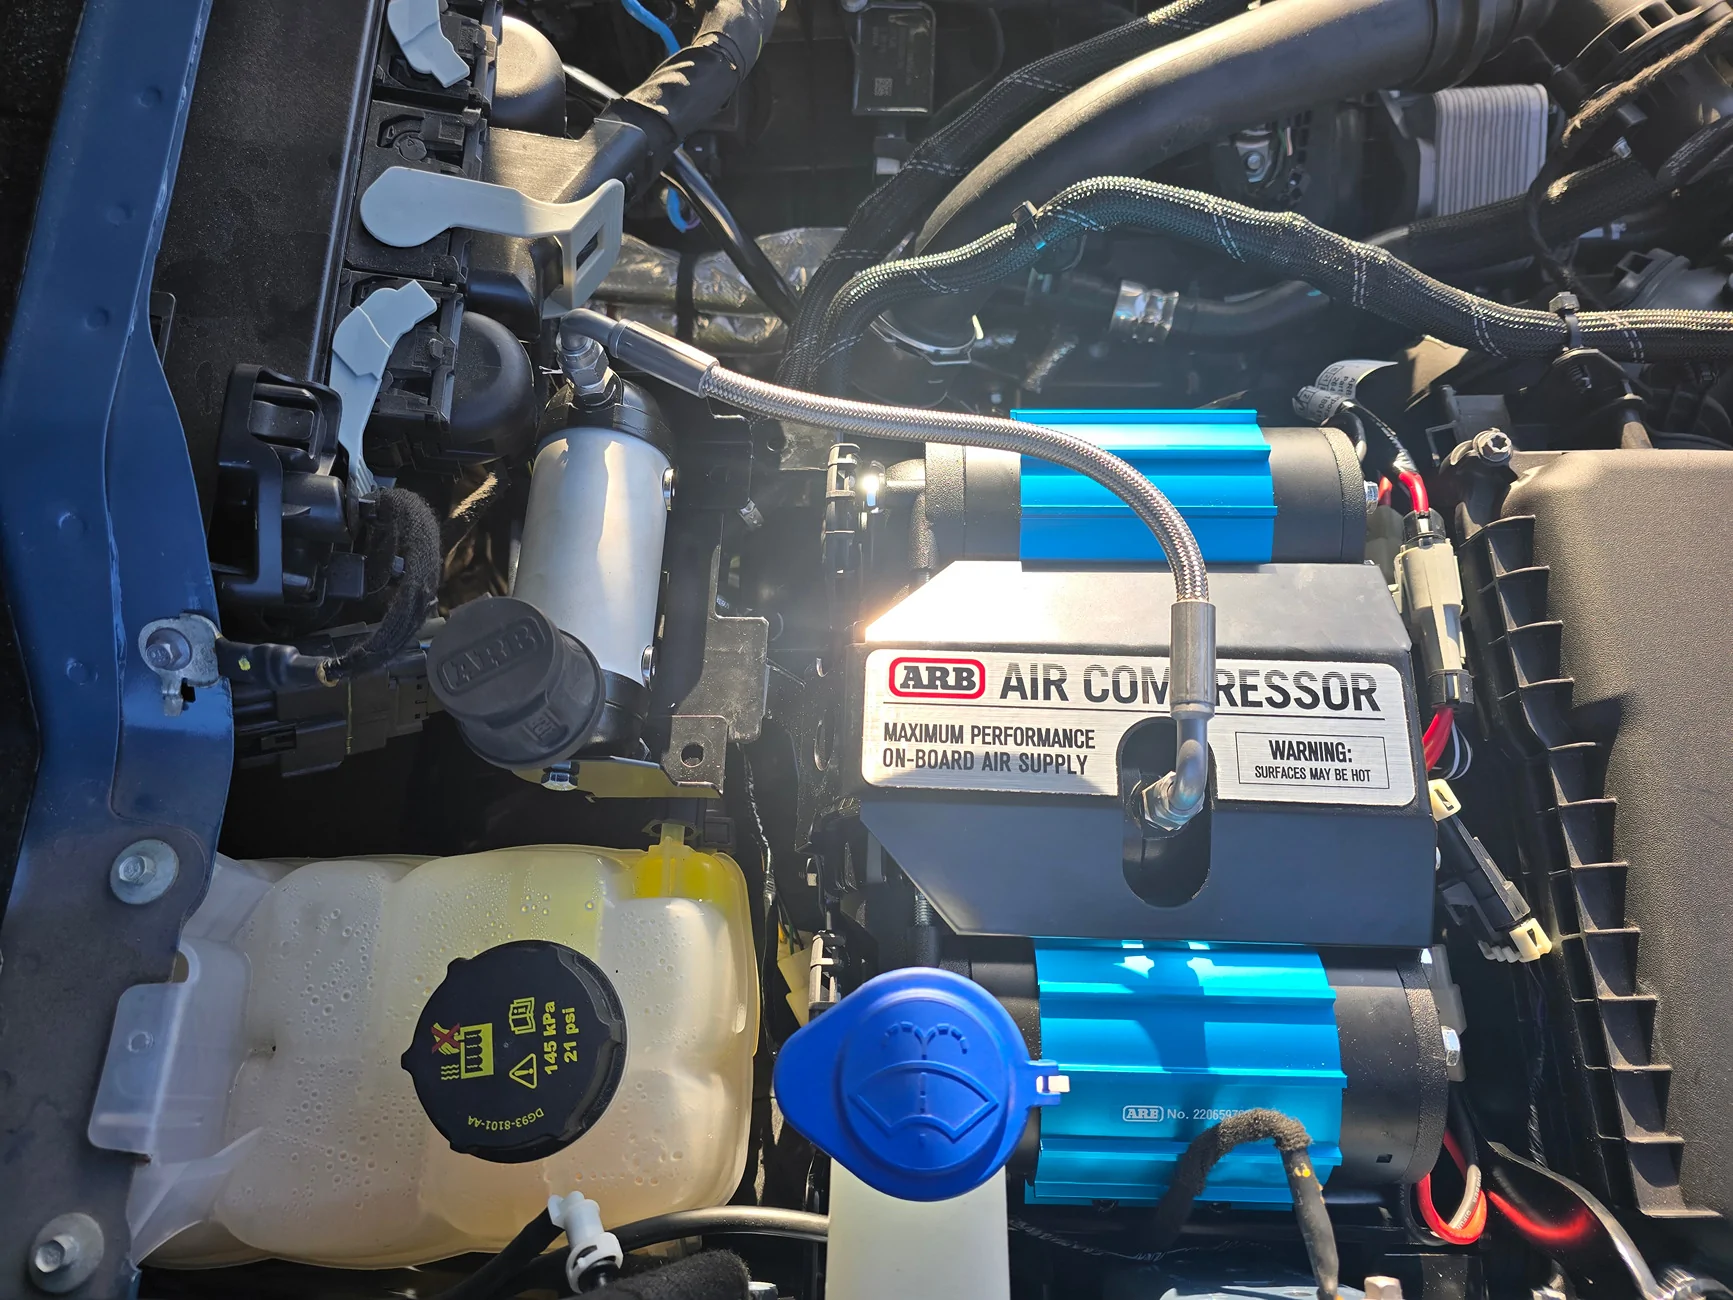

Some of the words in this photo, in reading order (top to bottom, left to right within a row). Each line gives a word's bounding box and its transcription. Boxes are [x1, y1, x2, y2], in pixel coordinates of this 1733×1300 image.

[455, 623, 538, 688] ARB
[899, 665, 977, 692] ARB
[1000, 662, 1069, 701] AIR
[1083, 664, 1382, 712] COMRESSOR
[883, 722, 964, 745] MAXIMUM
[970, 725, 1096, 749] PERFORMANCE
[882, 747, 975, 771] ON-BOARD
[981, 751, 1011, 772] AIR
[1018, 752, 1088, 775] SUPPLY
[1268, 739, 1353, 763] WARNING:
[1254, 765, 1307, 780] SURFACES
[1309, 767, 1331, 781] MAY
[1335, 768, 1349, 781] BE
[1352, 769, 1371, 782] HOT
[542, 1001, 557, 1037] kPa
[562, 1007, 579, 1034] psi
[543, 1040, 558, 1075] 145
[563, 1041, 578, 1063] 21
[467, 1107, 544, 1131] DG93-8101-AA
[1166, 1108, 1189, 1120] No.
